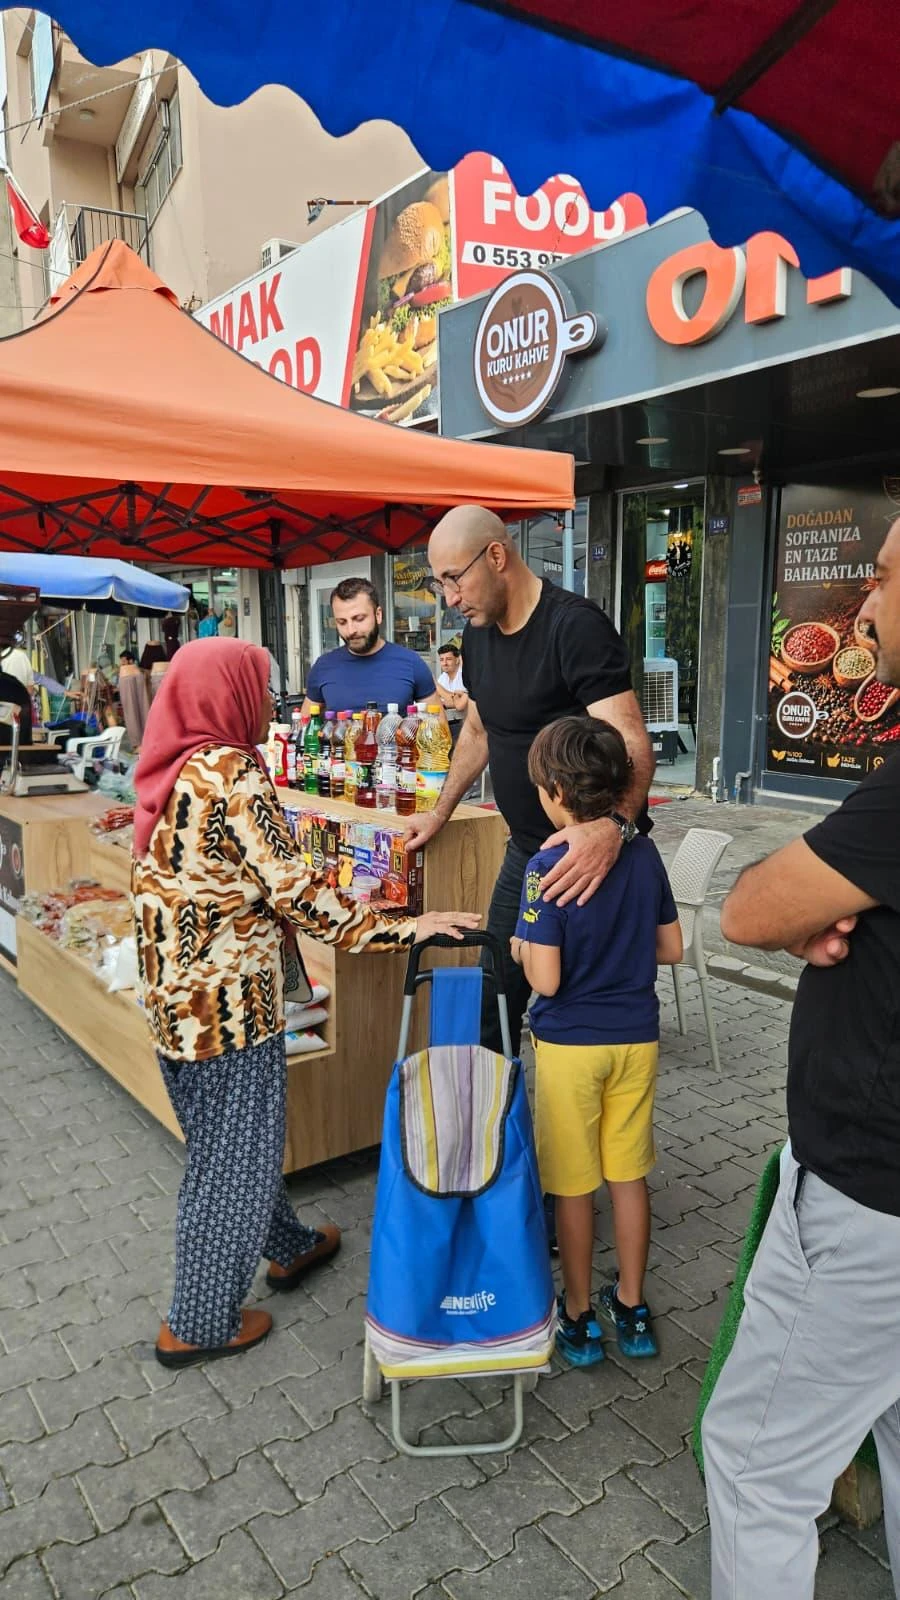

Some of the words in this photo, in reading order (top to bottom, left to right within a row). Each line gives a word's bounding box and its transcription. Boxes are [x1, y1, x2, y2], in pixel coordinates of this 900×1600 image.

[483, 179, 626, 240] FOOD
[473, 245, 486, 263] 0
[492, 248, 532, 269] 553
[209, 271, 285, 352] MAK
[486, 308, 549, 359] ONUR
[254, 336, 322, 396] OD
[487, 355, 513, 378] KURU
[515, 344, 549, 369] KAHVE
[786, 508, 854, 529] DOĞADAN
[785, 526, 861, 547] SOFRANIZA
[785, 549, 802, 564] EN
[805, 547, 838, 563] TAZE
[784, 563, 881, 582] BAHARATLAR
[782, 704, 811, 717] ONUR
